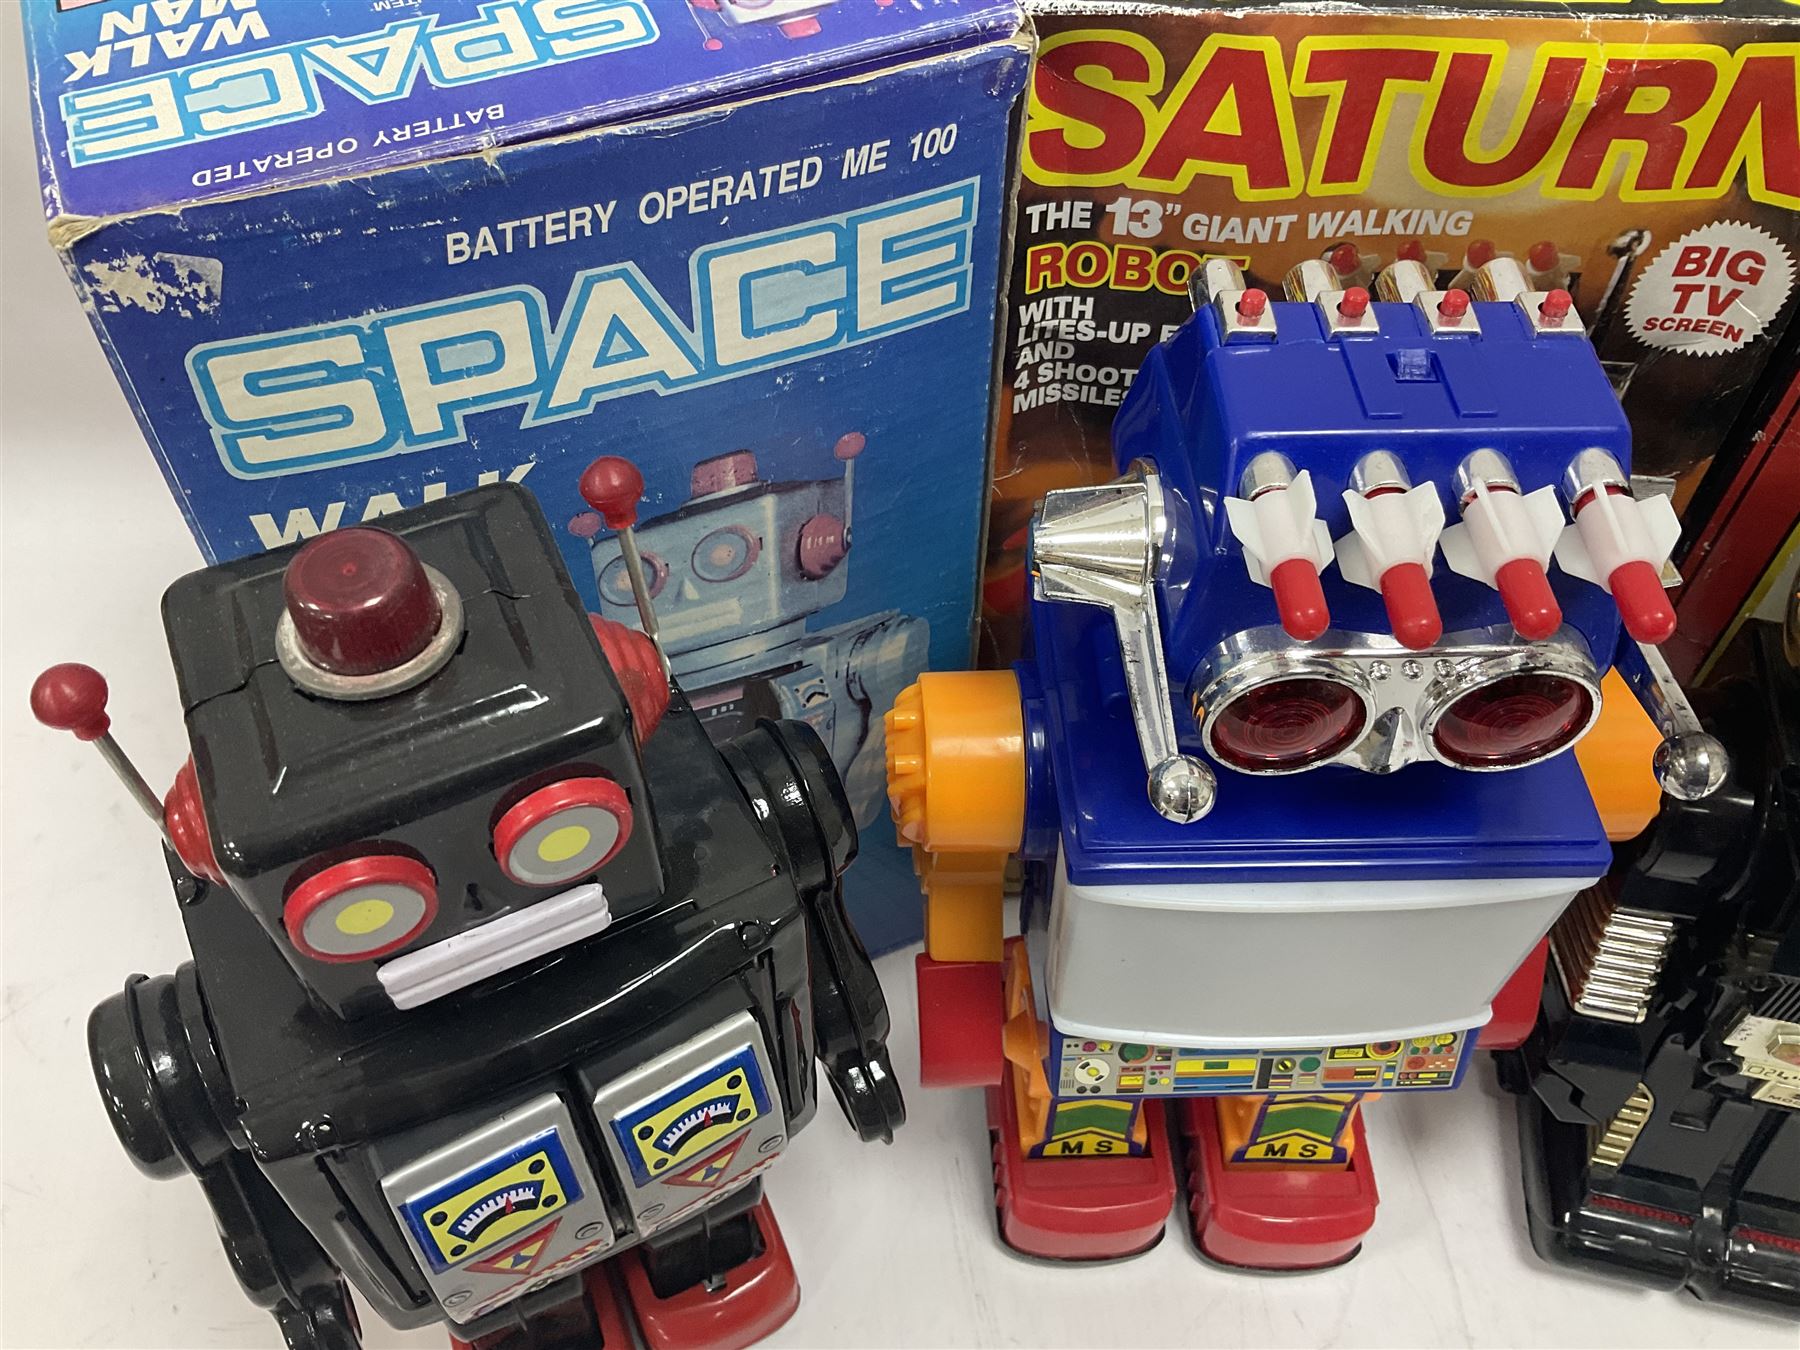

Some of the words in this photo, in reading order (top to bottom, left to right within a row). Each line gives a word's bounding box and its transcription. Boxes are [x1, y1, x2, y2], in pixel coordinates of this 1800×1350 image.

[63, 10, 271, 84] WALK
[58, 0, 661, 168] SPACE
[373, 103, 506, 148] BATTERY
[191, 138, 359, 187] OPERATED
[446, 200, 618, 266] BATTERY
[638, 155, 824, 226] OPERATED
[840, 140, 892, 181] ME
[909, 122, 959, 162] 100
[1025, 201, 1094, 234] THE
[1182, 212, 1299, 244] GIANT
[1306, 208, 1474, 240] WALKING
[1671, 245, 1767, 286] BIG
[1018, 296, 1095, 327] WITH
[1672, 283, 1744, 317] TV
[184, 175, 981, 481] SPACE
[1017, 319, 1151, 348] LITES-UP
[1642, 317, 1744, 343] SCREEN
[1013, 370, 1030, 391] 4
[1037, 361, 1141, 388] SHOOT
[1015, 341, 1075, 370] AND
[1012, 382, 1130, 414] MISSILE
